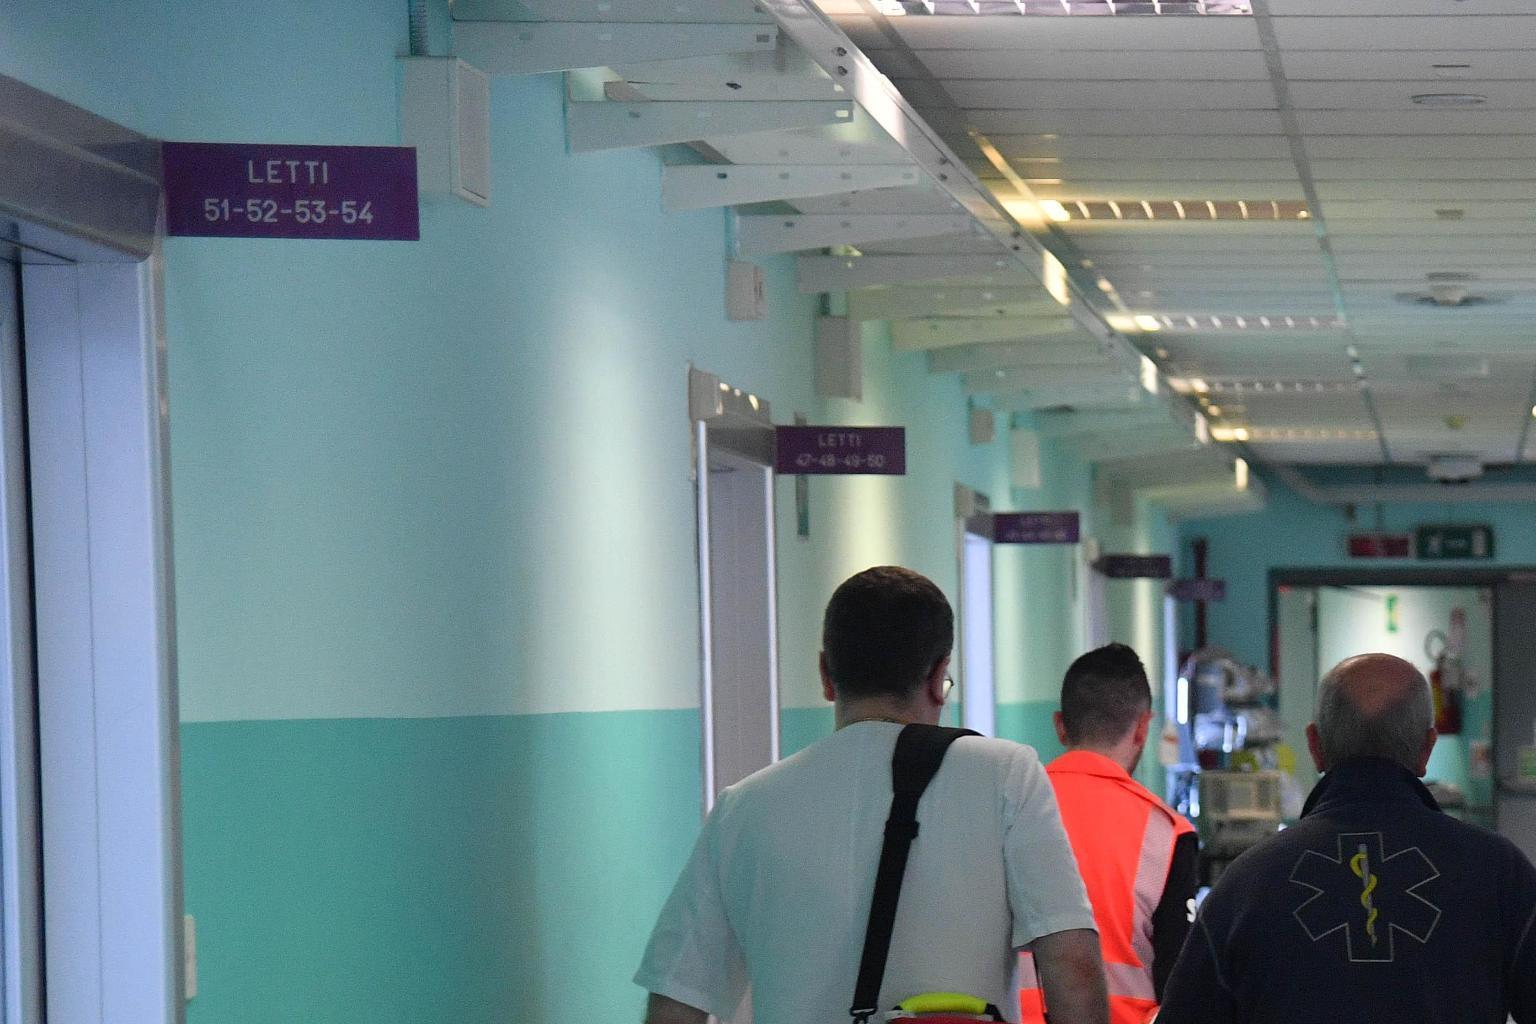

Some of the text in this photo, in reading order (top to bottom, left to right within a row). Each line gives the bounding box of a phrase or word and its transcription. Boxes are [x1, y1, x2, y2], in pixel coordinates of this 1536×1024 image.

[247, 159, 330, 185] LETTI
[203, 198, 375, 224] 51-52-53-54
[818, 432, 862, 448] LETTI
